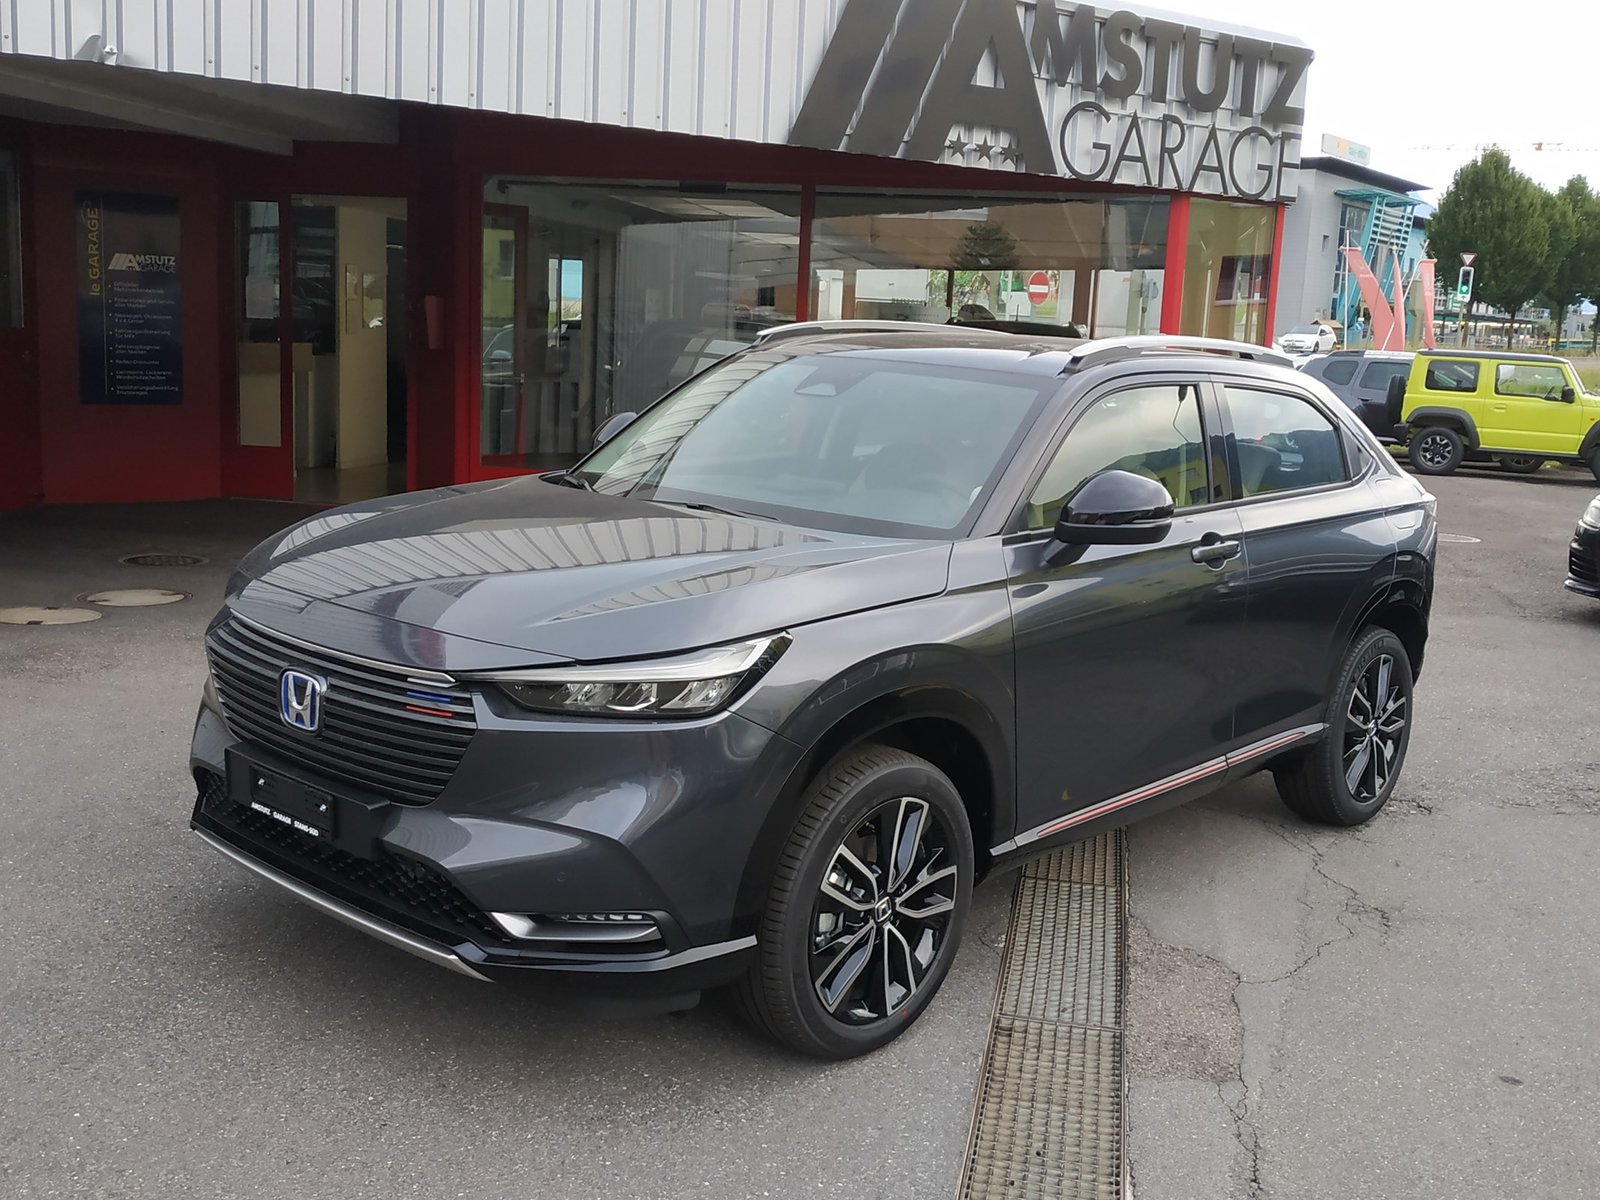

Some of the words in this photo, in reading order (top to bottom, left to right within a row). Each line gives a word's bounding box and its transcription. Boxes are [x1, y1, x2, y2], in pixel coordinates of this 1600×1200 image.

[893, 0, 1314, 176] AMSTUTZ
[1059, 101, 1303, 203] GARAGE
[87, 207, 101, 279] GARAGE
[122, 253, 176, 271] AMSTUTZ
[89, 284, 100, 296] le
[139, 263, 177, 274] GARAGE
